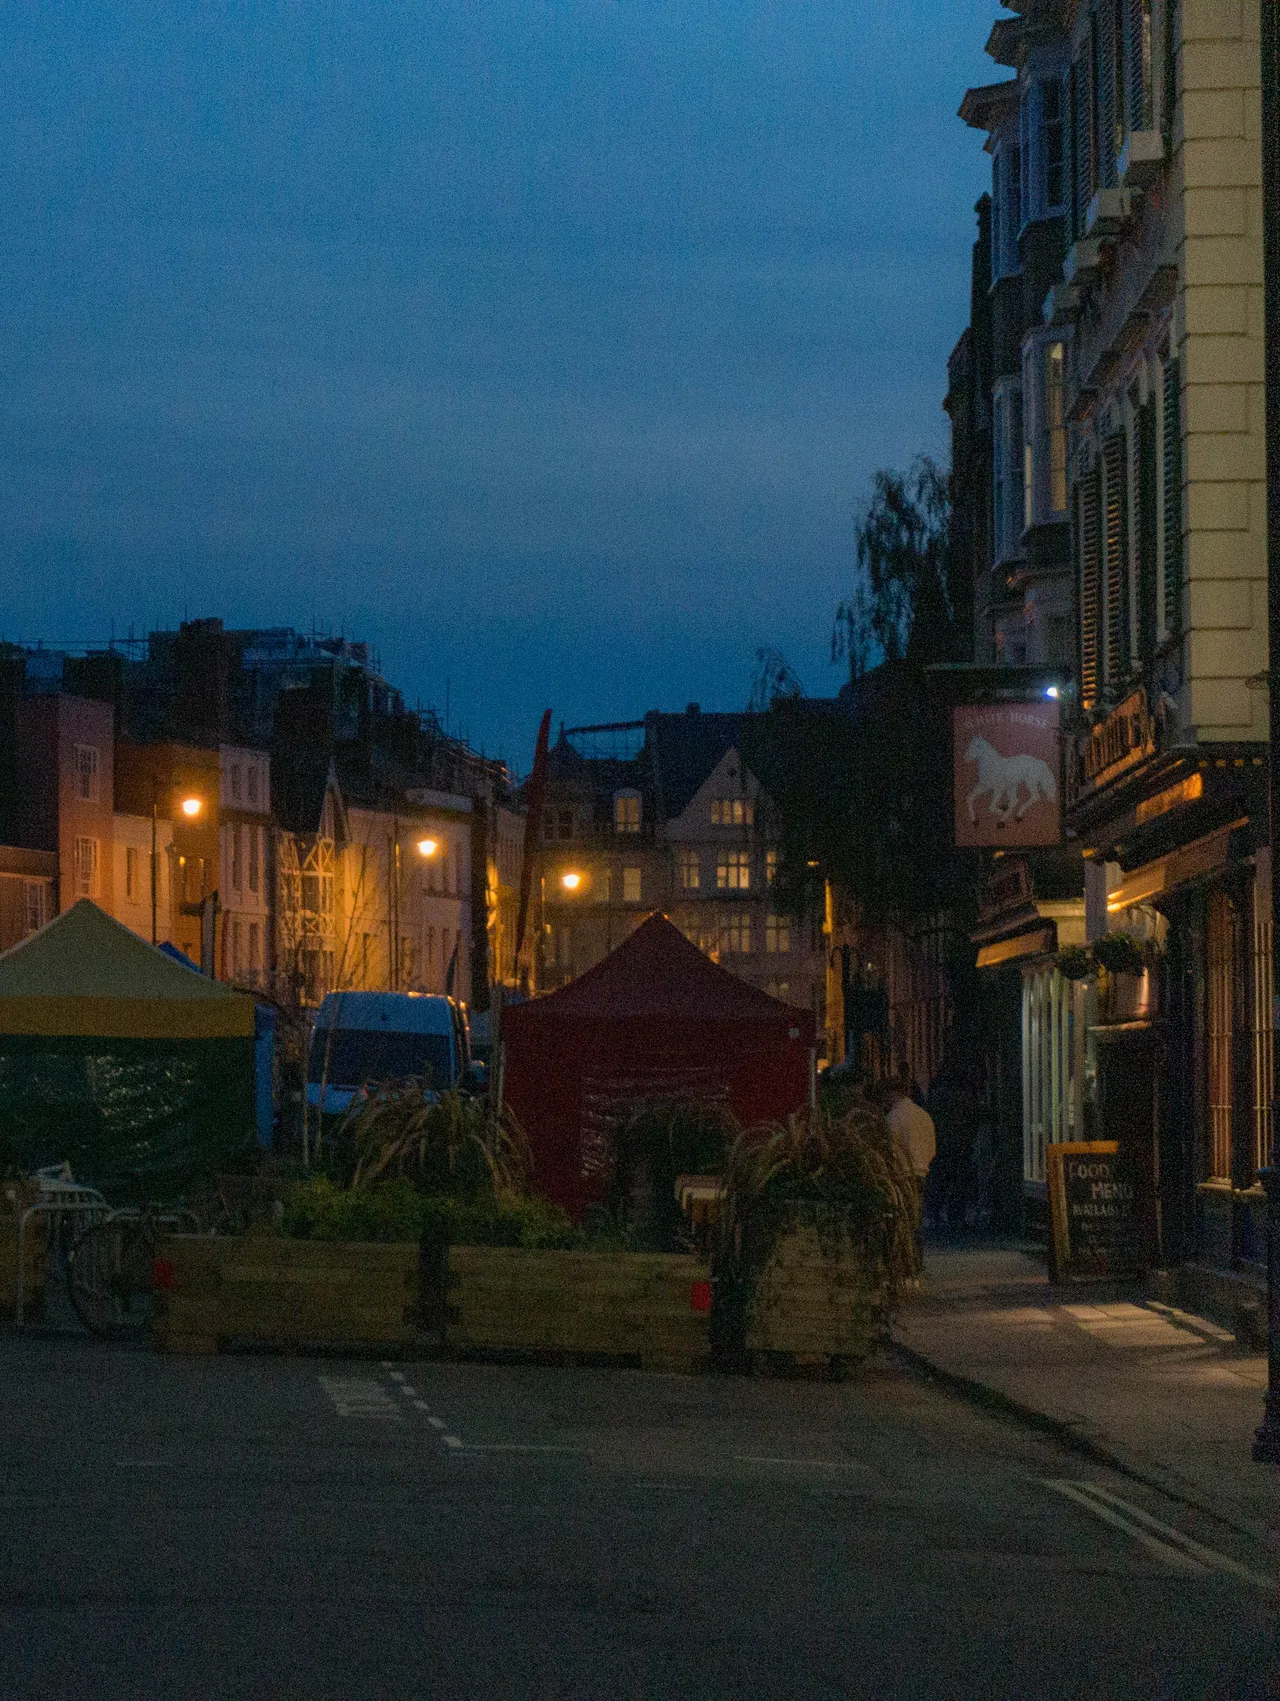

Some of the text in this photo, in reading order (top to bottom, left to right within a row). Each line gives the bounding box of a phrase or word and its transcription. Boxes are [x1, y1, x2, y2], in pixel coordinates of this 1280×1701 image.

[1009, 711, 1050, 729] HORSE
[1069, 1161, 1110, 1181] FOOD
[1091, 1182, 1134, 1200] MENU
